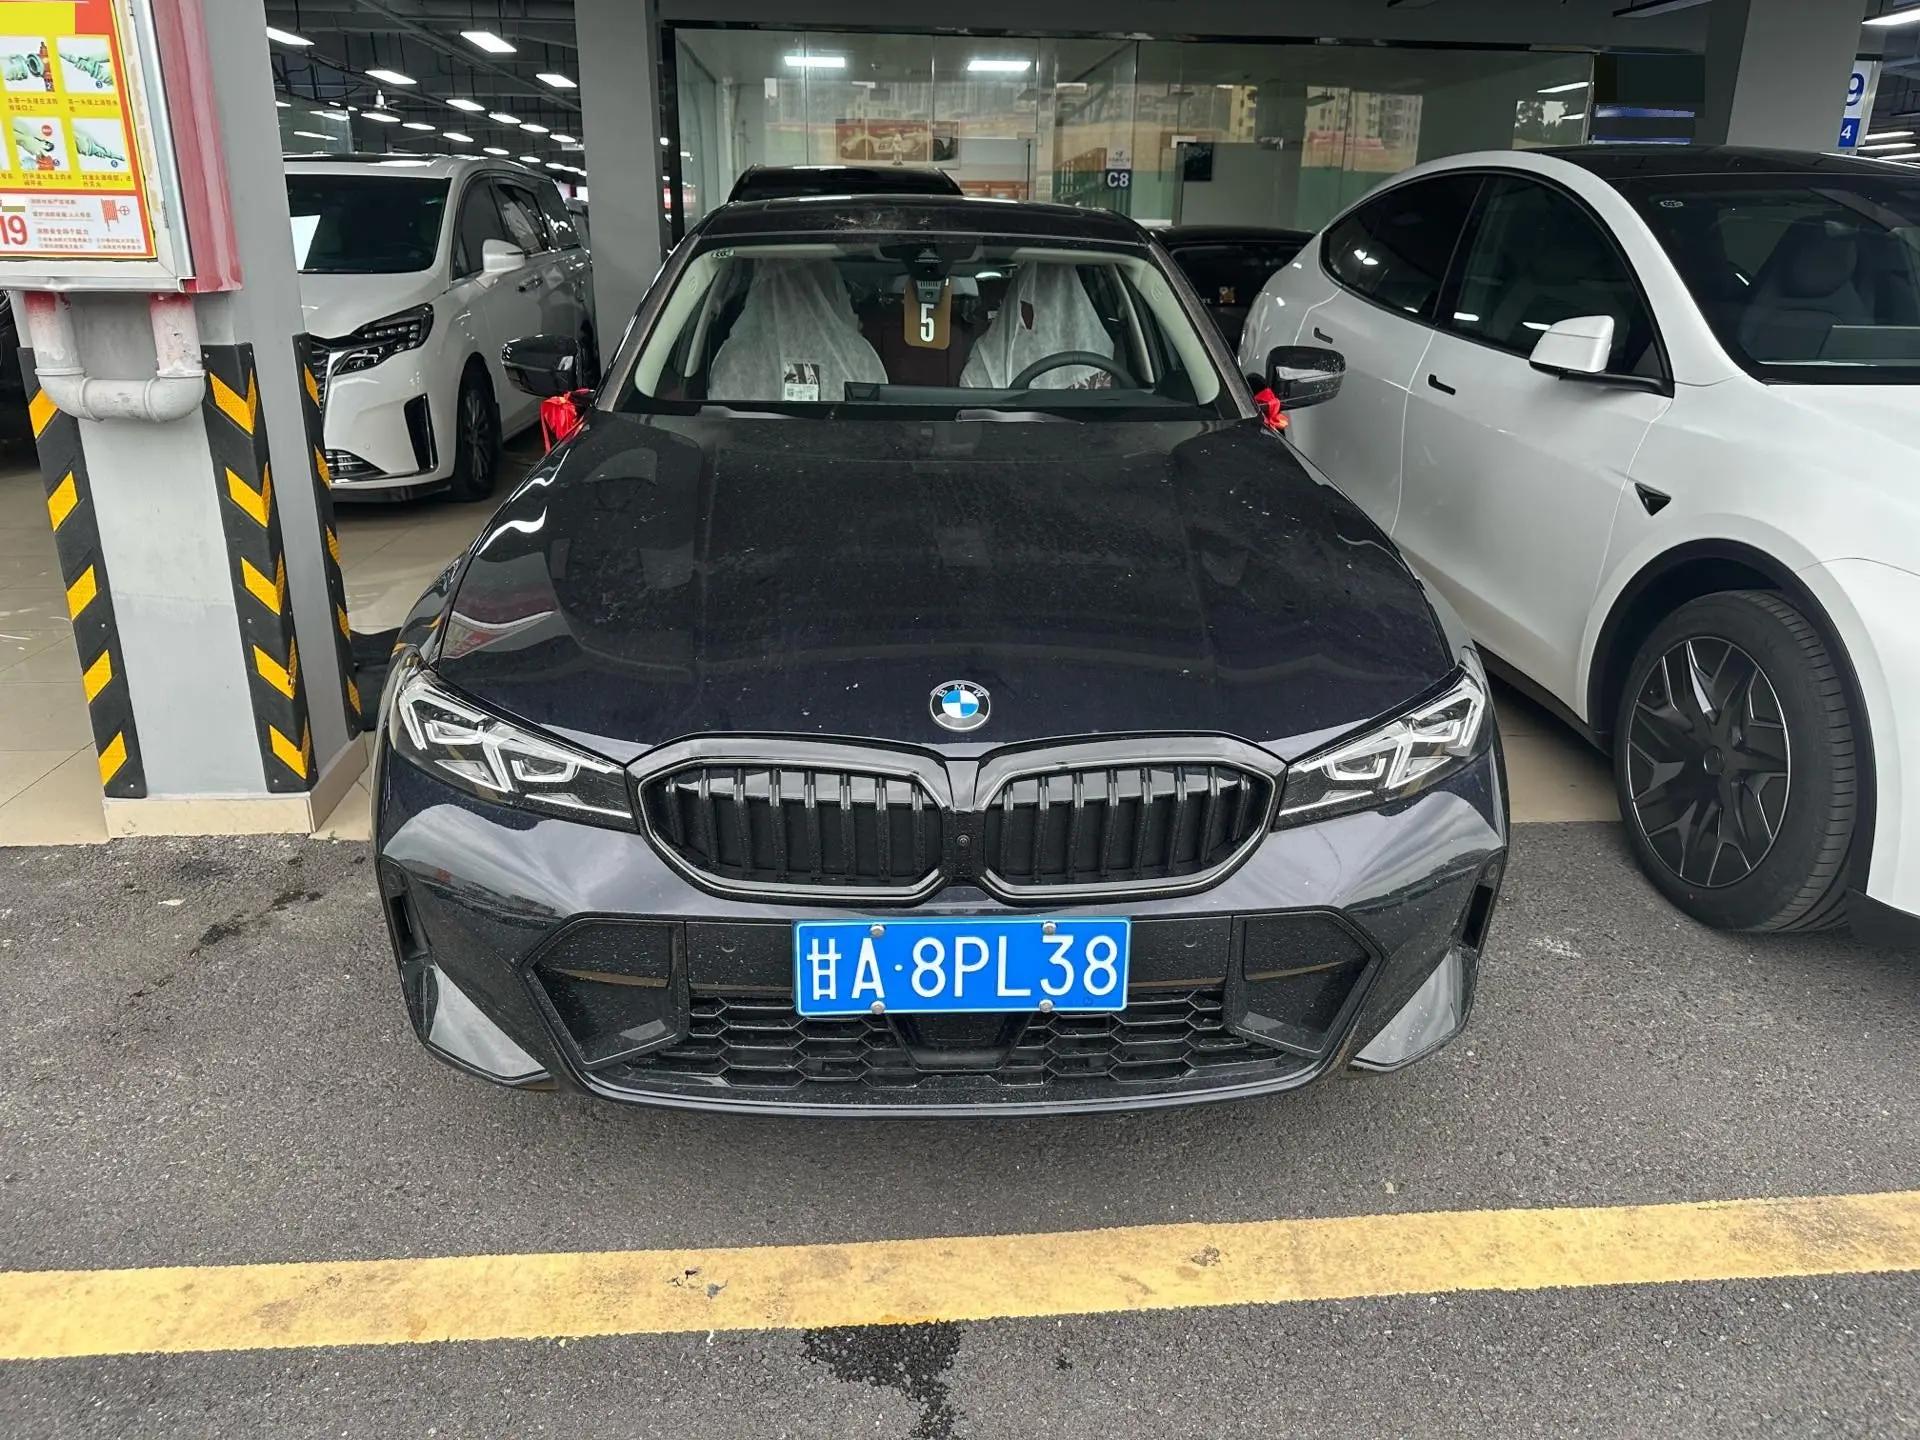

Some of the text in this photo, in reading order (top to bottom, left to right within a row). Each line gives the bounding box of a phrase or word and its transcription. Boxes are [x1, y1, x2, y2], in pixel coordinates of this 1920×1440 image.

[1840, 125, 1852, 139] 4
[1107, 172, 1129, 187] C8
[920, 303, 935, 342] 5
[937, 684, 984, 698] BMW
[807, 935, 1118, 1000] 甘A·8PL38
